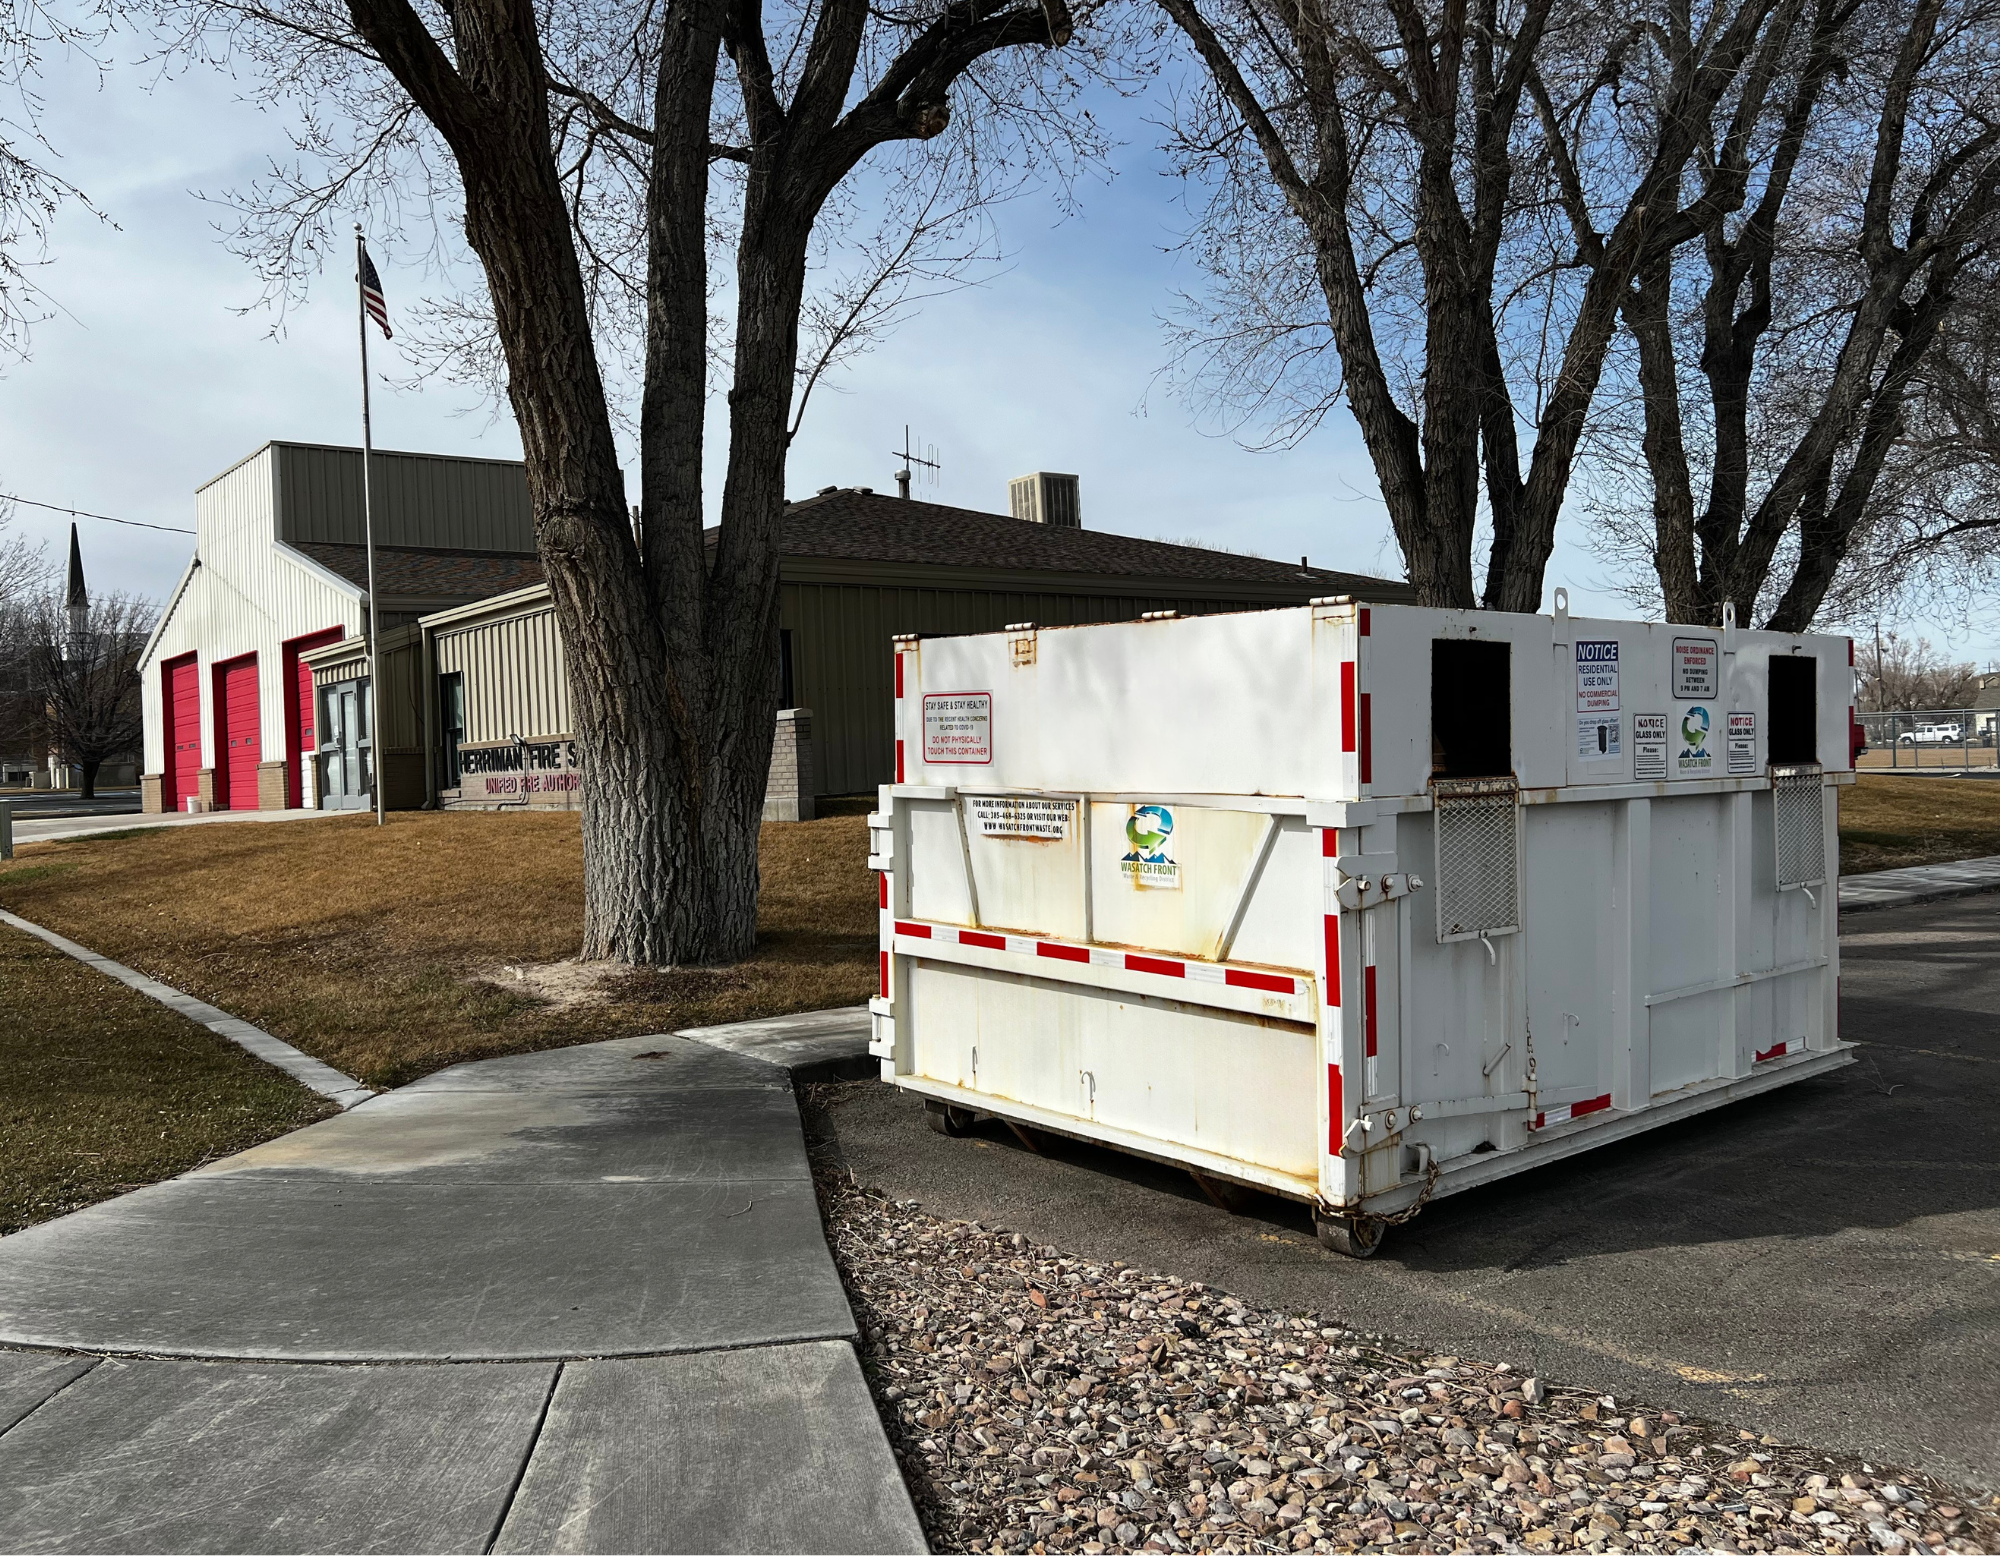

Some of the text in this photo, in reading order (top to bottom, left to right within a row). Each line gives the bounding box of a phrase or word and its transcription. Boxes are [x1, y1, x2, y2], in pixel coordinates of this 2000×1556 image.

[1577, 644, 1617, 660] NOTICE
[1676, 646, 1714, 655] NOISE ORDINANCE
[1684, 657, 1706, 665] ENFORCED
[1578, 664, 1617, 674] RESIDENTIAL
[1583, 676, 1613, 686] USE ONLY
[1579, 690, 1617, 699] NO COMMERCIAL
[926, 700, 988, 710] STAY SAFE & STAY HEALTHY
[1587, 699, 1610, 707] DUMPING
[1638, 719, 1664, 728] NOTICE
[1730, 717, 1753, 726] NOTICE
[1636, 731, 1665, 739] GLASS ONLY
[952, 736, 982, 744] PHYSICALLY
[928, 747, 988, 755] TOUCH THIS CONTAINER
[459, 747, 523, 774] HERRIMAN
[529, 743, 561, 770] FIRE
[1678, 758, 1711, 768] WASATCH FRONT
[486, 776, 518, 794] UNIFIED
[542, 773, 580, 792] AUTHOR
[982, 800, 994, 808] MORE
[995, 800, 1025, 809] INFORMATION
[1026, 801, 1040, 809] ABOUT
[1042, 802, 1051, 810] OUR
[1053, 802, 1075, 811] SERVICES
[1034, 813, 1046, 821] VISIT
[1057, 814, 1070, 822] WEB:
[1121, 862, 1177, 875] WASATCH FRONT
